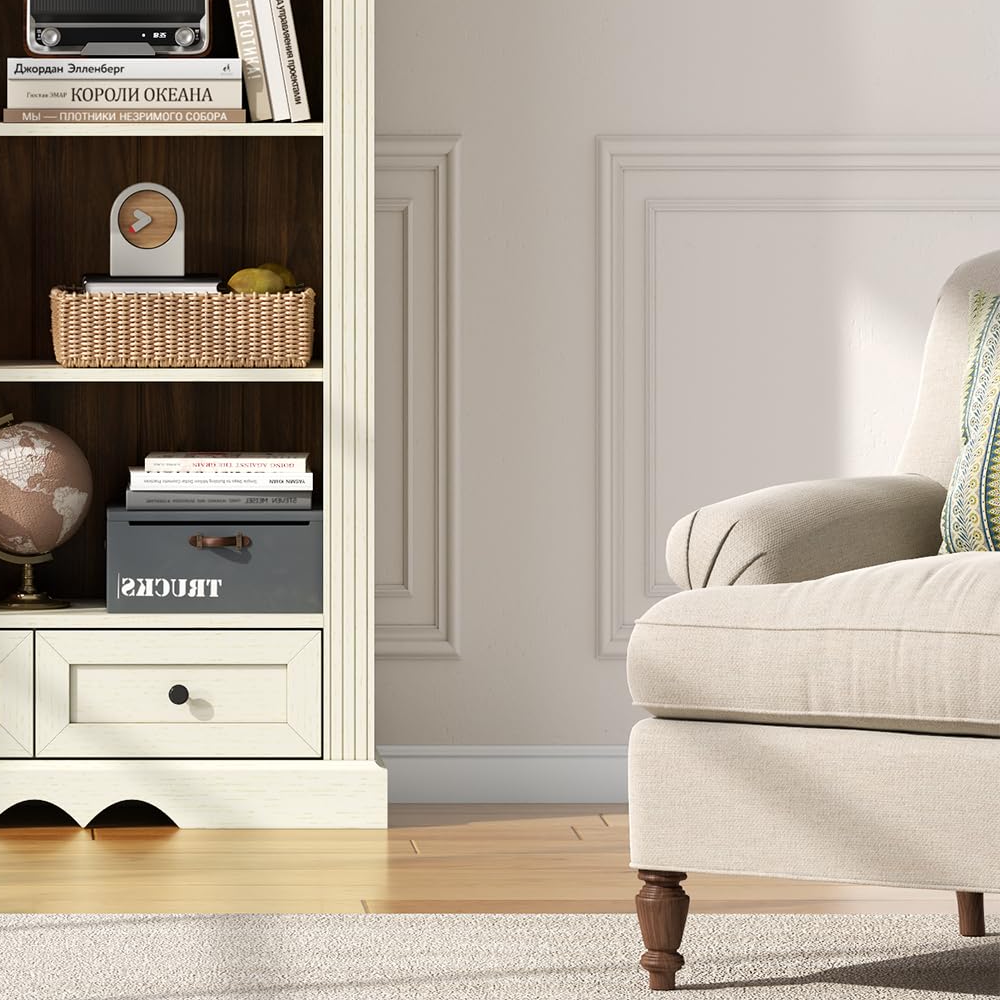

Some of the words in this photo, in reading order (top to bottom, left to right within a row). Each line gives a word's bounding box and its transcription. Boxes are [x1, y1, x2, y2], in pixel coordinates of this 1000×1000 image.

[14, 64, 64, 75] Джордан
[68, 64, 125, 75] Элленберг
[287, 59, 303, 105] проектами
[71, 88, 140, 102] КОРОЛИ
[144, 88, 213, 102] ОКЕАНА
[22, 112, 41, 121] МЫ
[60, 112, 116, 121] ПЛОТНИКИ
[120, 112, 183, 121] НЕЗРИМОГО
[186, 112, 227, 121] СОБОРА
